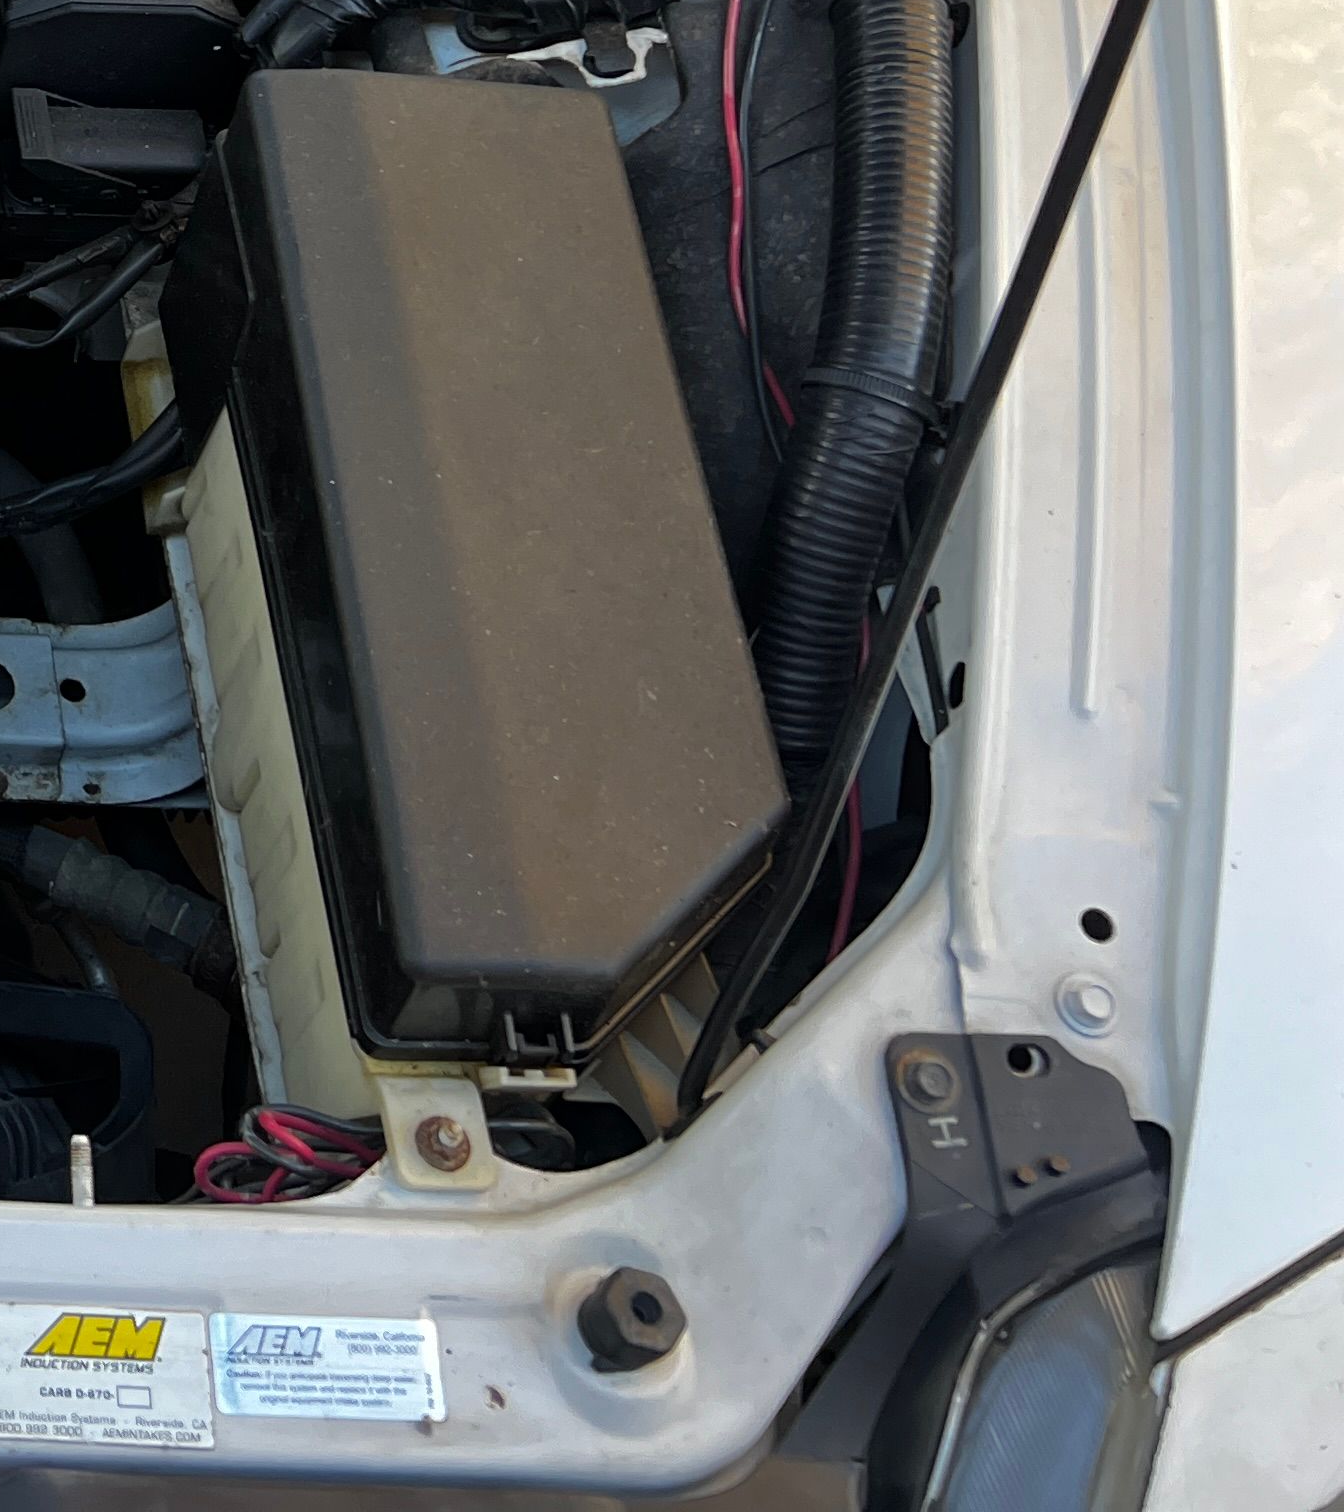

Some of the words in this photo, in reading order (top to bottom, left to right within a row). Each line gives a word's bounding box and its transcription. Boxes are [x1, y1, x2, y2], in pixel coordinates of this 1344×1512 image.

[24, 1312, 166, 1362] AEM
[226, 1324, 322, 1357] AEM
[383, 1331, 425, 1342] California
[19, 1357, 89, 1371] INDUCTION
[92, 1361, 154, 1375] SYSTEMS
[39, 1386, 71, 1398] CARB
[19, 1411, 67, 1424] Induction
[71, 1412, 117, 1425] Systems
[192, 1419, 208, 1430] CA
